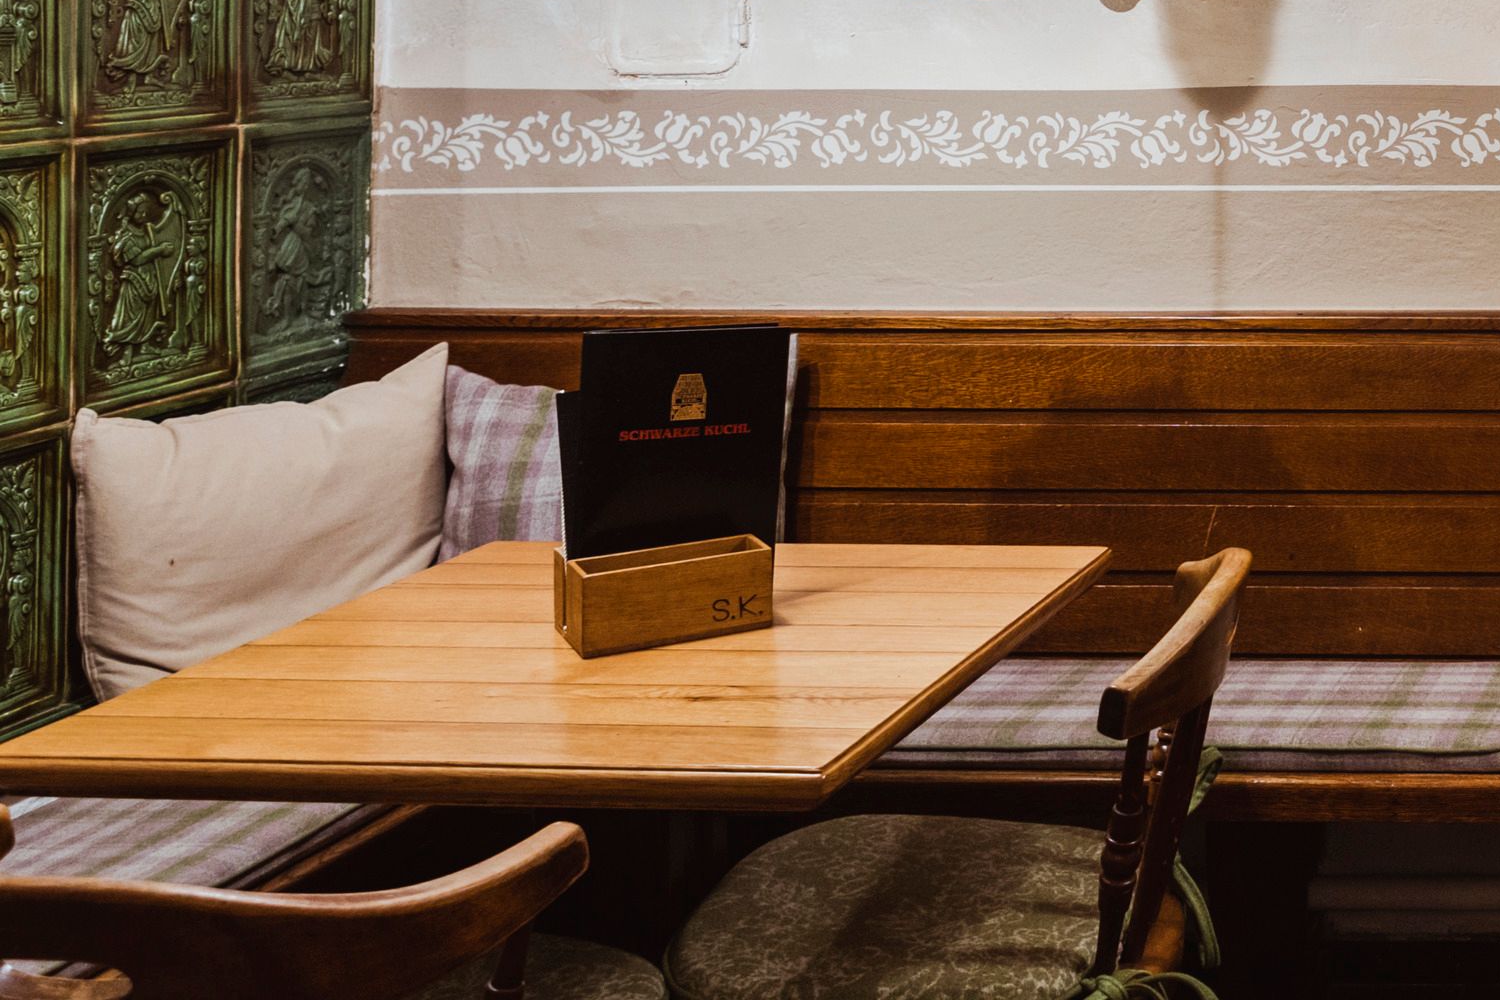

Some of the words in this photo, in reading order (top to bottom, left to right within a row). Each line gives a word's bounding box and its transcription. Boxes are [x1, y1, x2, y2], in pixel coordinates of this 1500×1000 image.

[618, 427, 700, 441] SCHWARZE
[704, 423, 752, 437] KUCHL
[711, 594, 764, 622] S.K.
